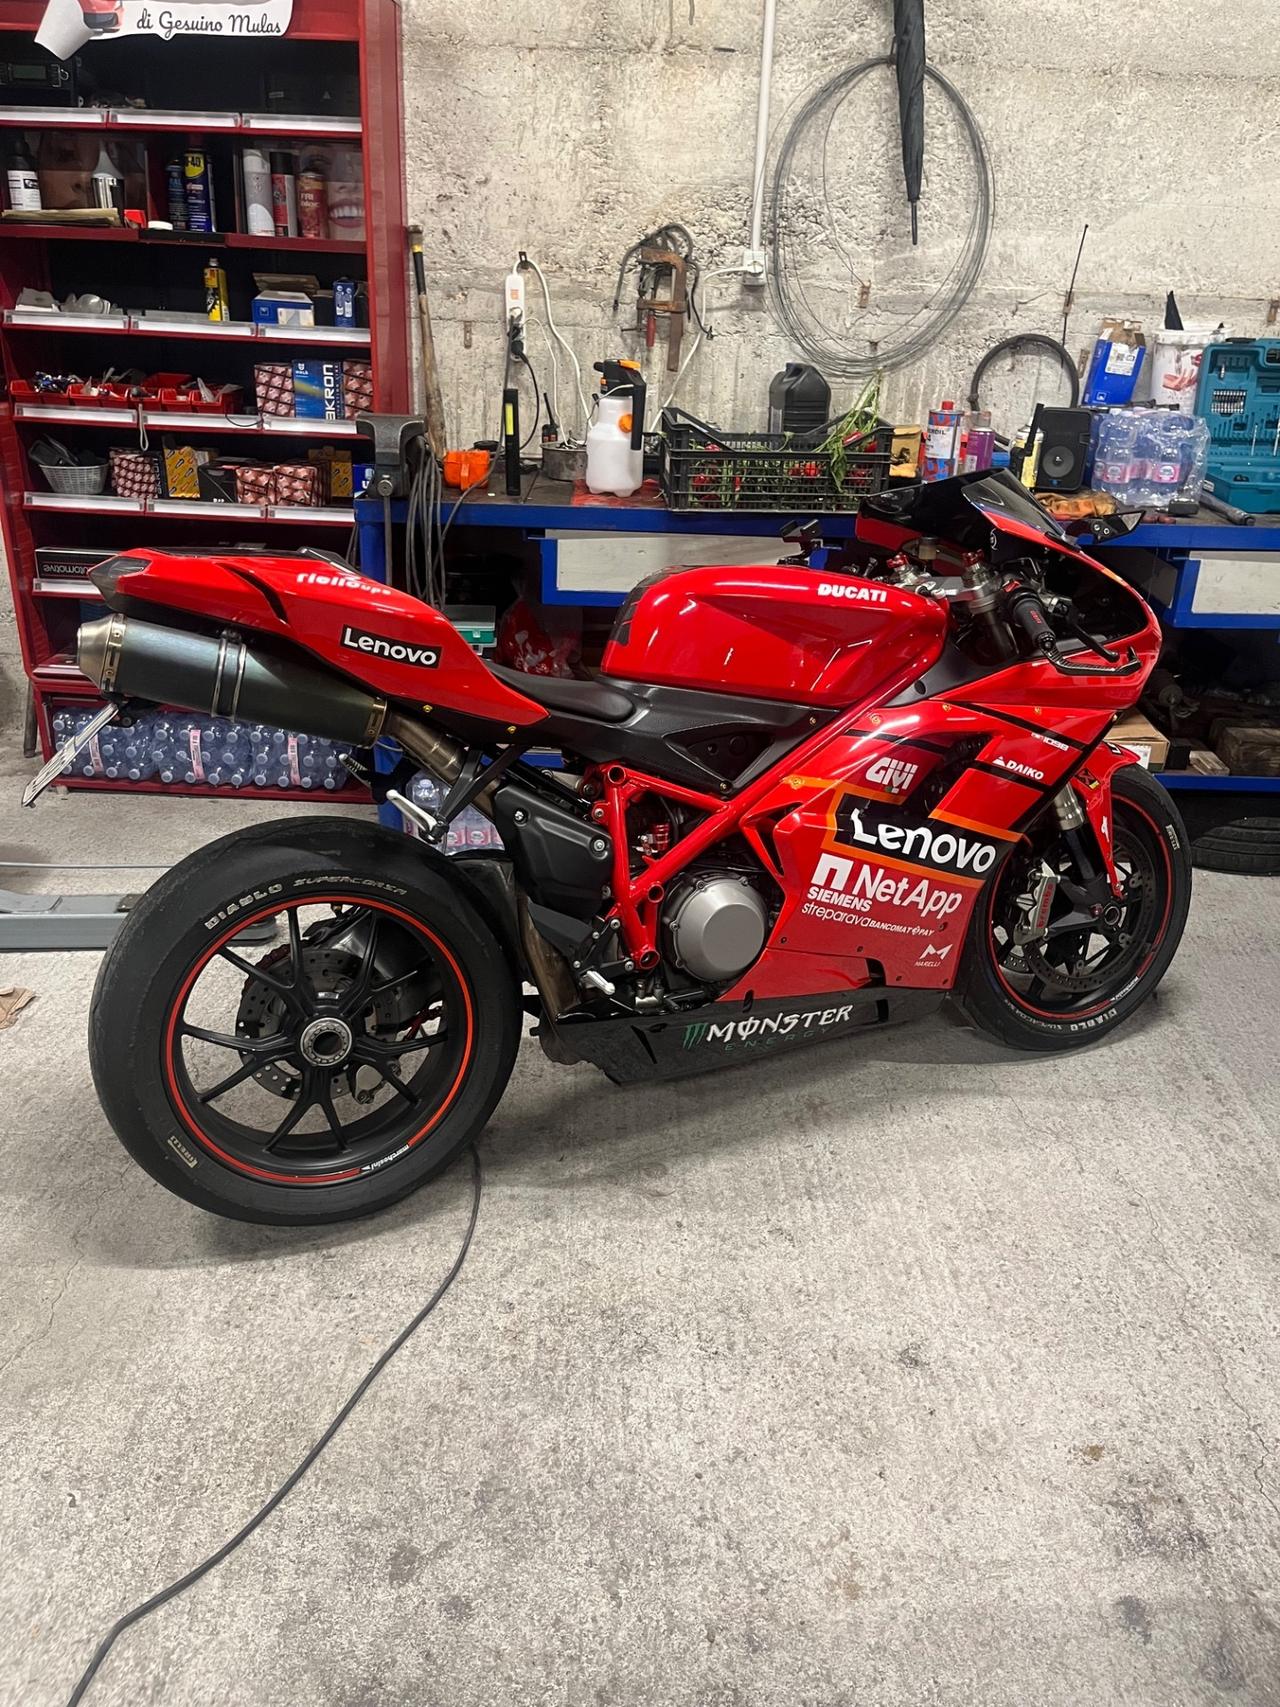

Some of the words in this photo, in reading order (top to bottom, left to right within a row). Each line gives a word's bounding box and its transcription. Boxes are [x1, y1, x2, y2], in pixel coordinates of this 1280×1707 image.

[136, 7, 154, 30] di
[158, 10, 223, 39] Gesuino
[227, 12, 282, 34] Mulas
[42, 563, 89, 577] utomotive
[817, 583, 888, 603] DUCATI
[343, 627, 438, 666] Lenovo
[865, 756, 919, 795] GIVI
[1005, 759, 1045, 780] DAIKO
[850, 807, 997, 874] Lenovo
[292, 875, 408, 896] SUPERCORSA
[851, 864, 963, 920] NetApp
[204, 883, 283, 930] DIABLO
[806, 886, 873, 913] SIEMENS
[801, 901, 871, 927] streparava
[868, 920, 913, 935] BANCOMAT
[918, 928, 936, 937] PAY
[913, 960, 942, 968] MARELLI
[706, 1004, 853, 1043] MONSTER
[1070, 1007, 1118, 1032] DIABLO
